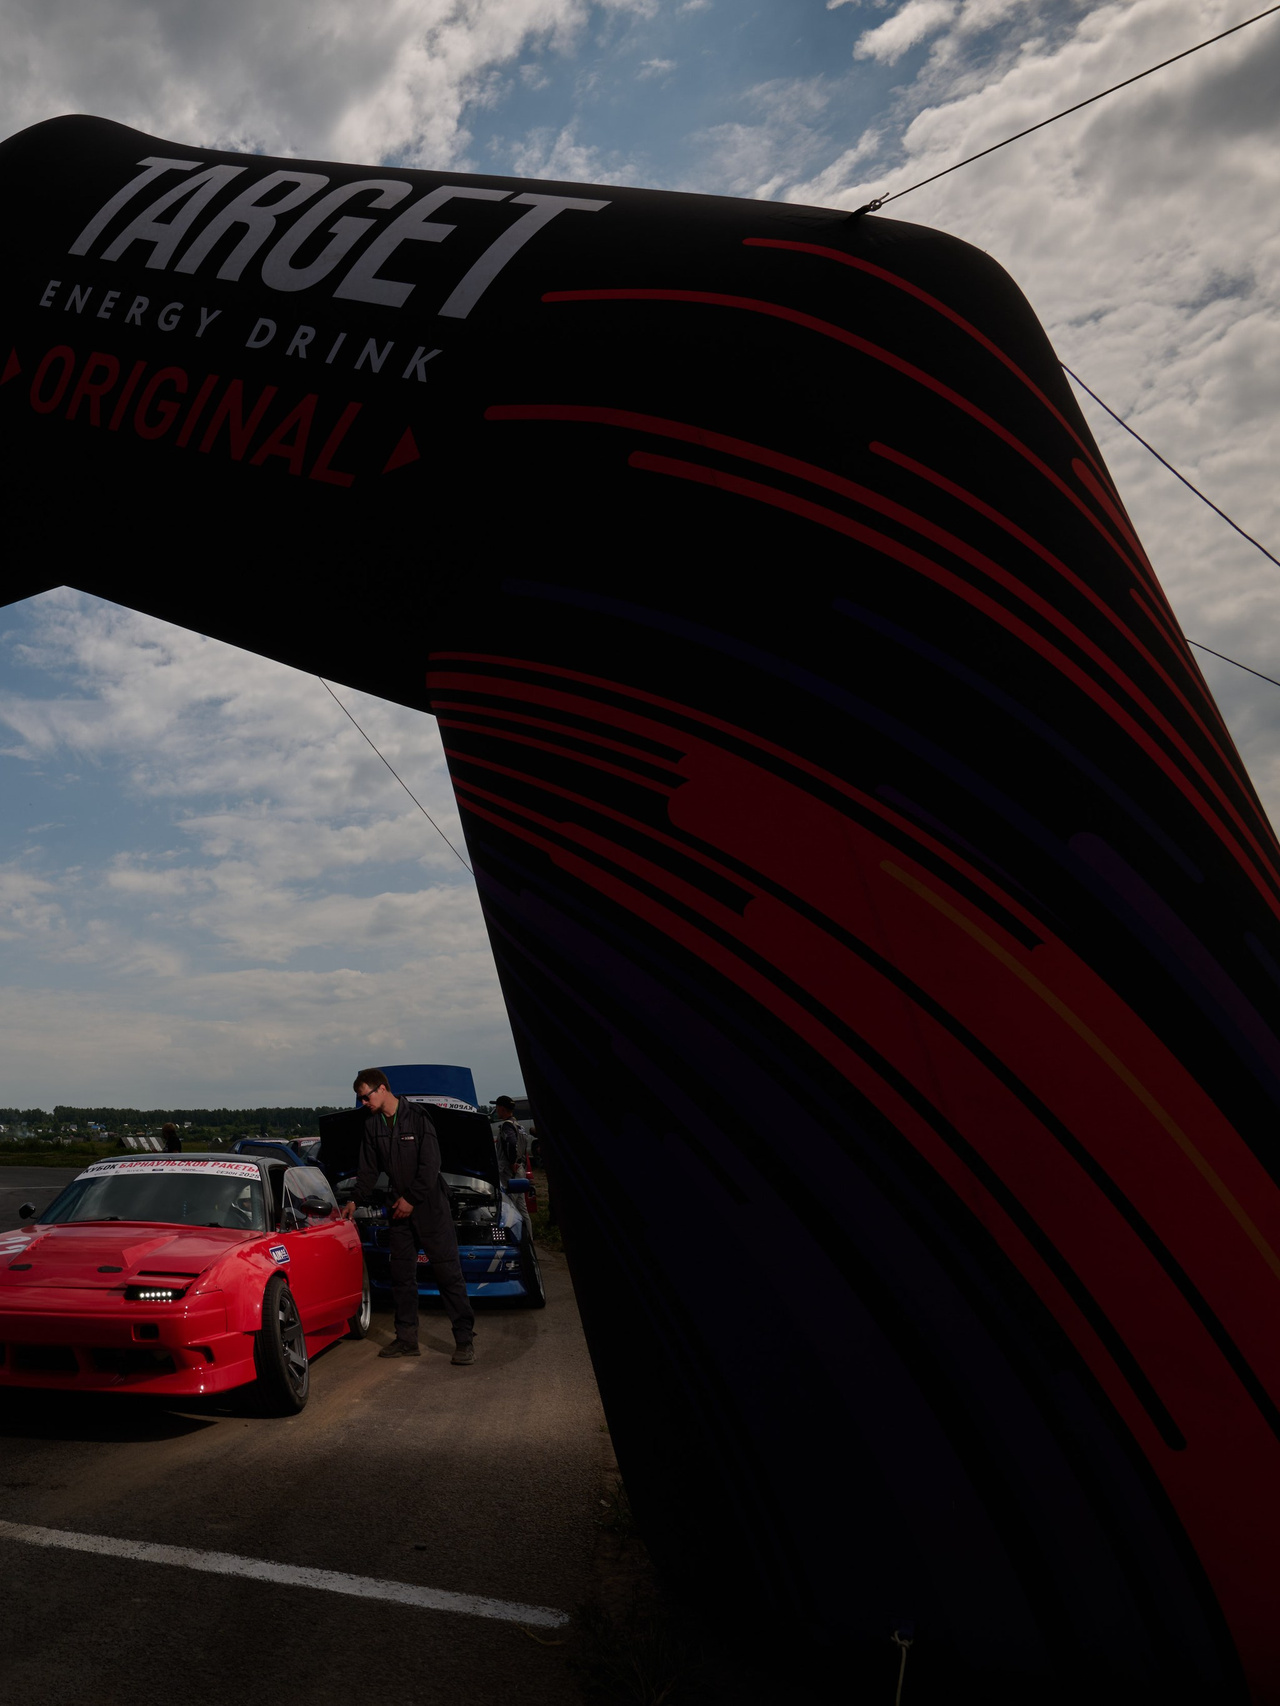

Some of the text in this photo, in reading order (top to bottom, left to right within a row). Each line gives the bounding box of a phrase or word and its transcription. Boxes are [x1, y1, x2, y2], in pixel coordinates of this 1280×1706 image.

[68, 156, 613, 320] TARGET
[39, 280, 444, 384] ENERGY DRINK
[29, 344, 364, 488] ORIGINAL
[83, 1164, 119, 1174] КУБОК
[119, 1160, 208, 1169] БАРНАУЛЬСКОЙ
